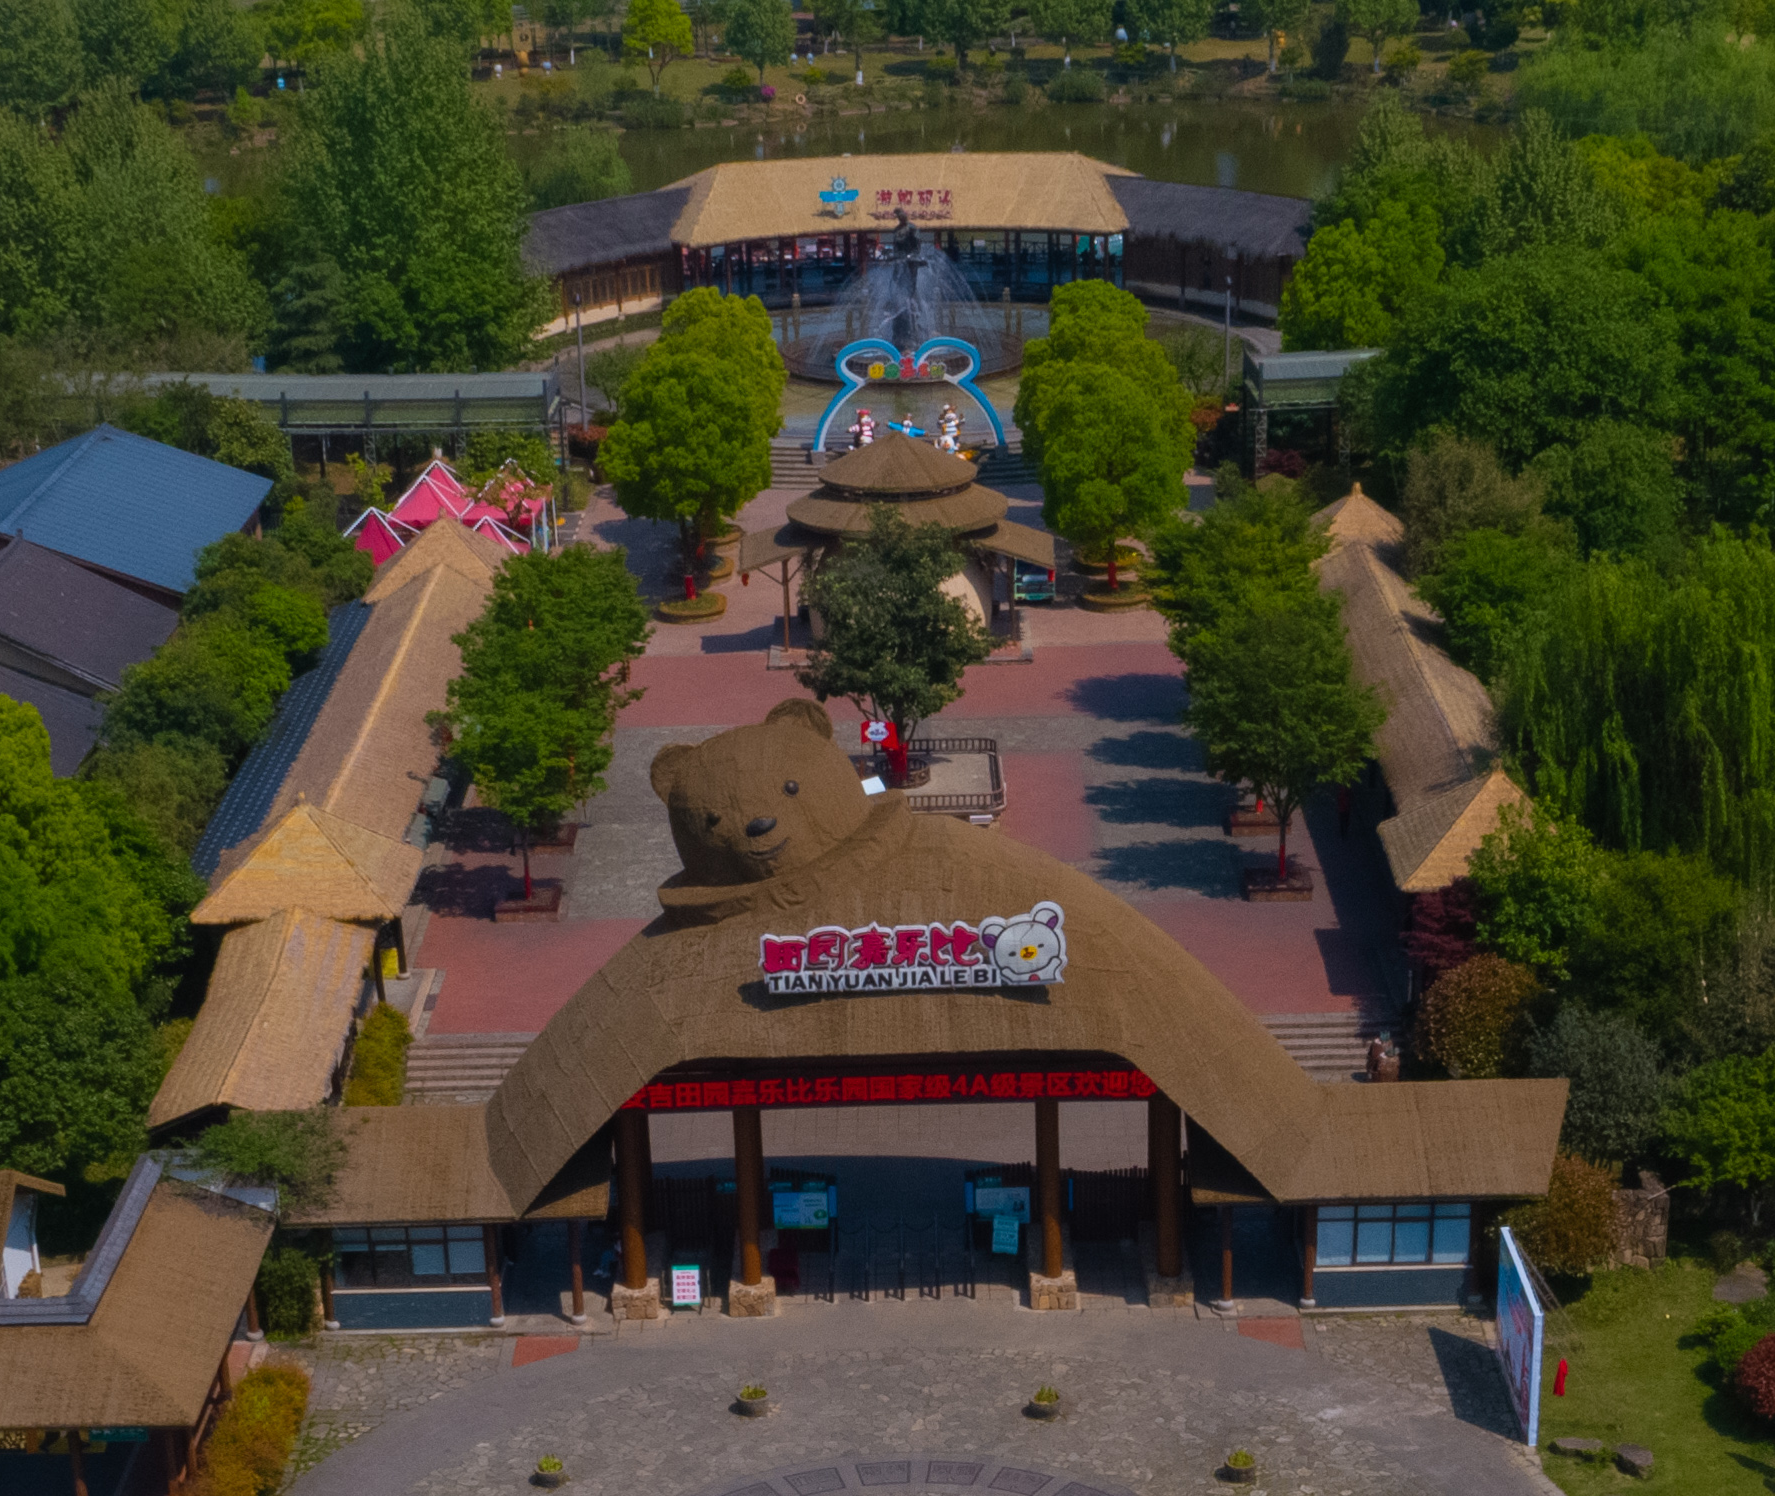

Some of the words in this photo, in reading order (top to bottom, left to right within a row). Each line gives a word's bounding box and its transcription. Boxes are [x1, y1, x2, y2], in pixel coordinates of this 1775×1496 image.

[762, 926, 980, 974] 田园嘉乐比
[769, 974, 828, 991] TIAN
[827, 973, 893, 990] YUAN
[898, 971, 934, 987] JIA
[940, 969, 967, 986] LE
[973, 968, 997, 985] BI
